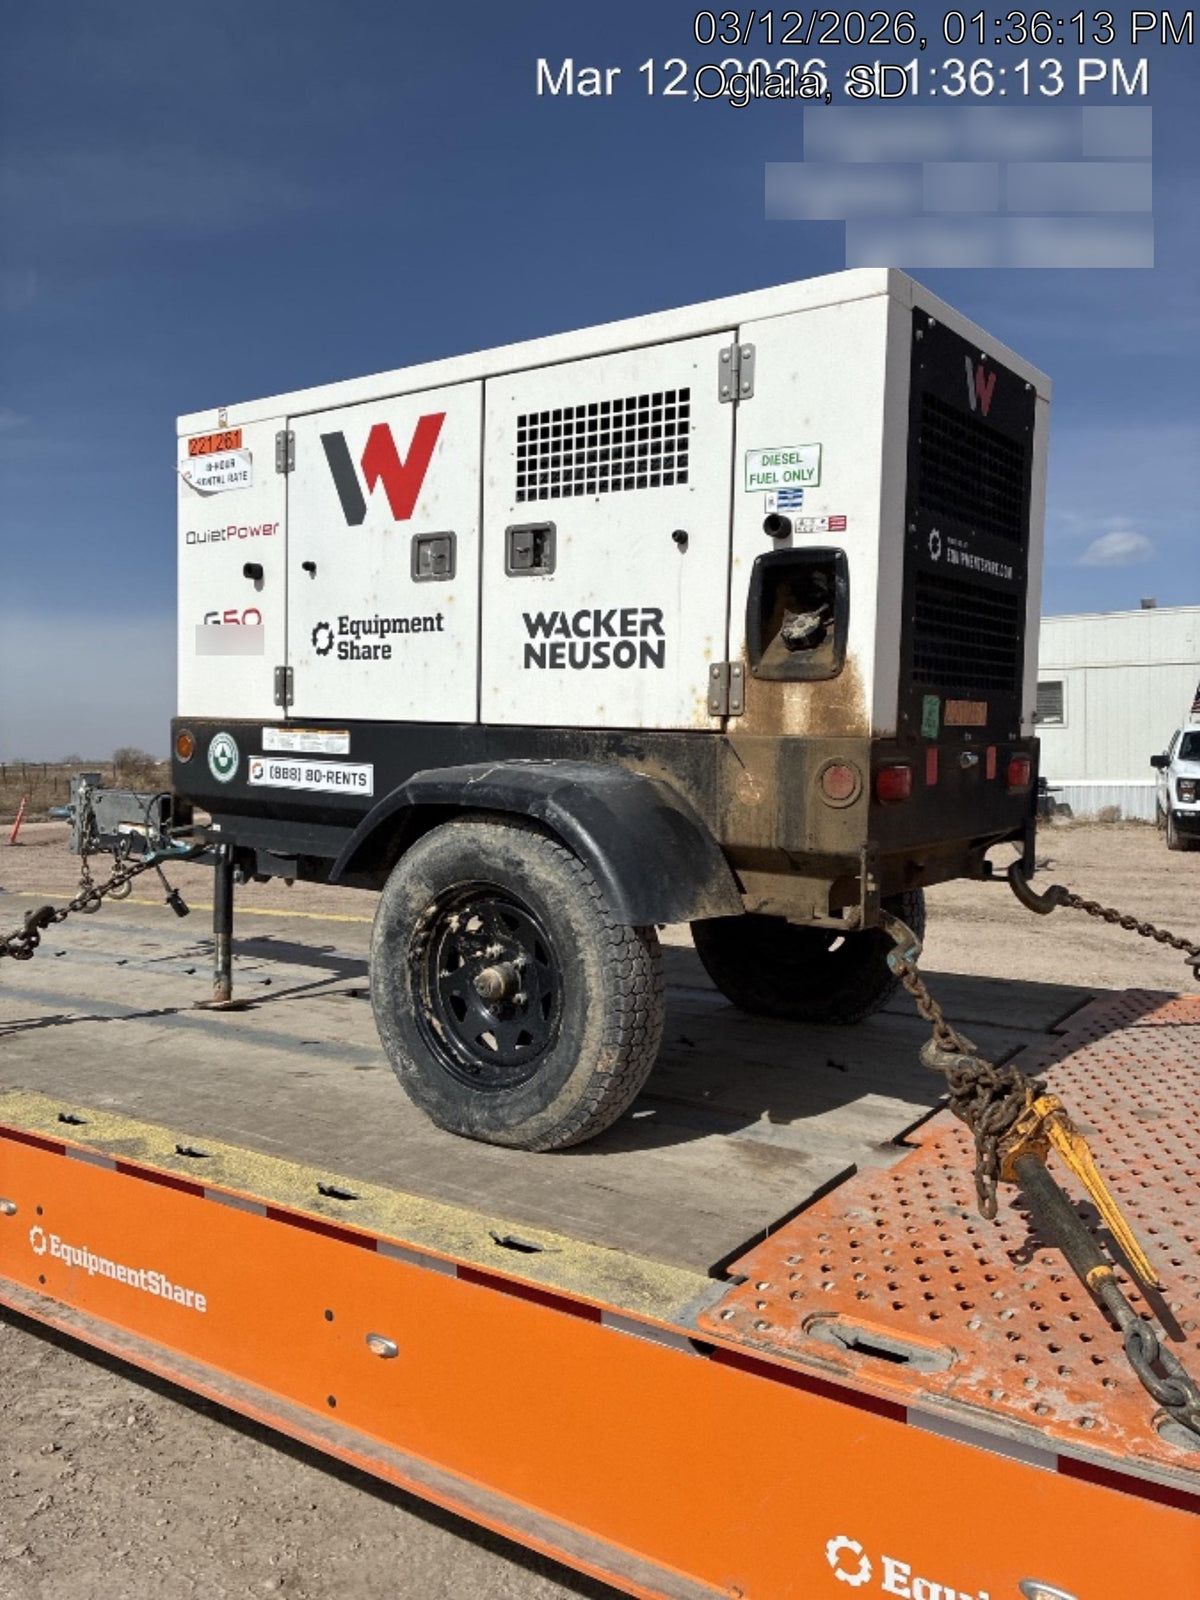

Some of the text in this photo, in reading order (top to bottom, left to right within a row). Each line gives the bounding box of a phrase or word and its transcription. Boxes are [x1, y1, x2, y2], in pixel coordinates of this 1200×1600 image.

[761, 453, 803, 467] DIESEL
[749, 468, 815, 485] FUEL ONLY
[185, 522, 280, 545] QuietPower
[337, 612, 445, 640] Equipment
[522, 608, 666, 639] WACKER
[337, 640, 392, 660] Share
[524, 640, 666, 670] NEUSON
[305, 765, 367, 787] 80-RENTS
[49, 1233, 207, 1313] EquipmentShare
